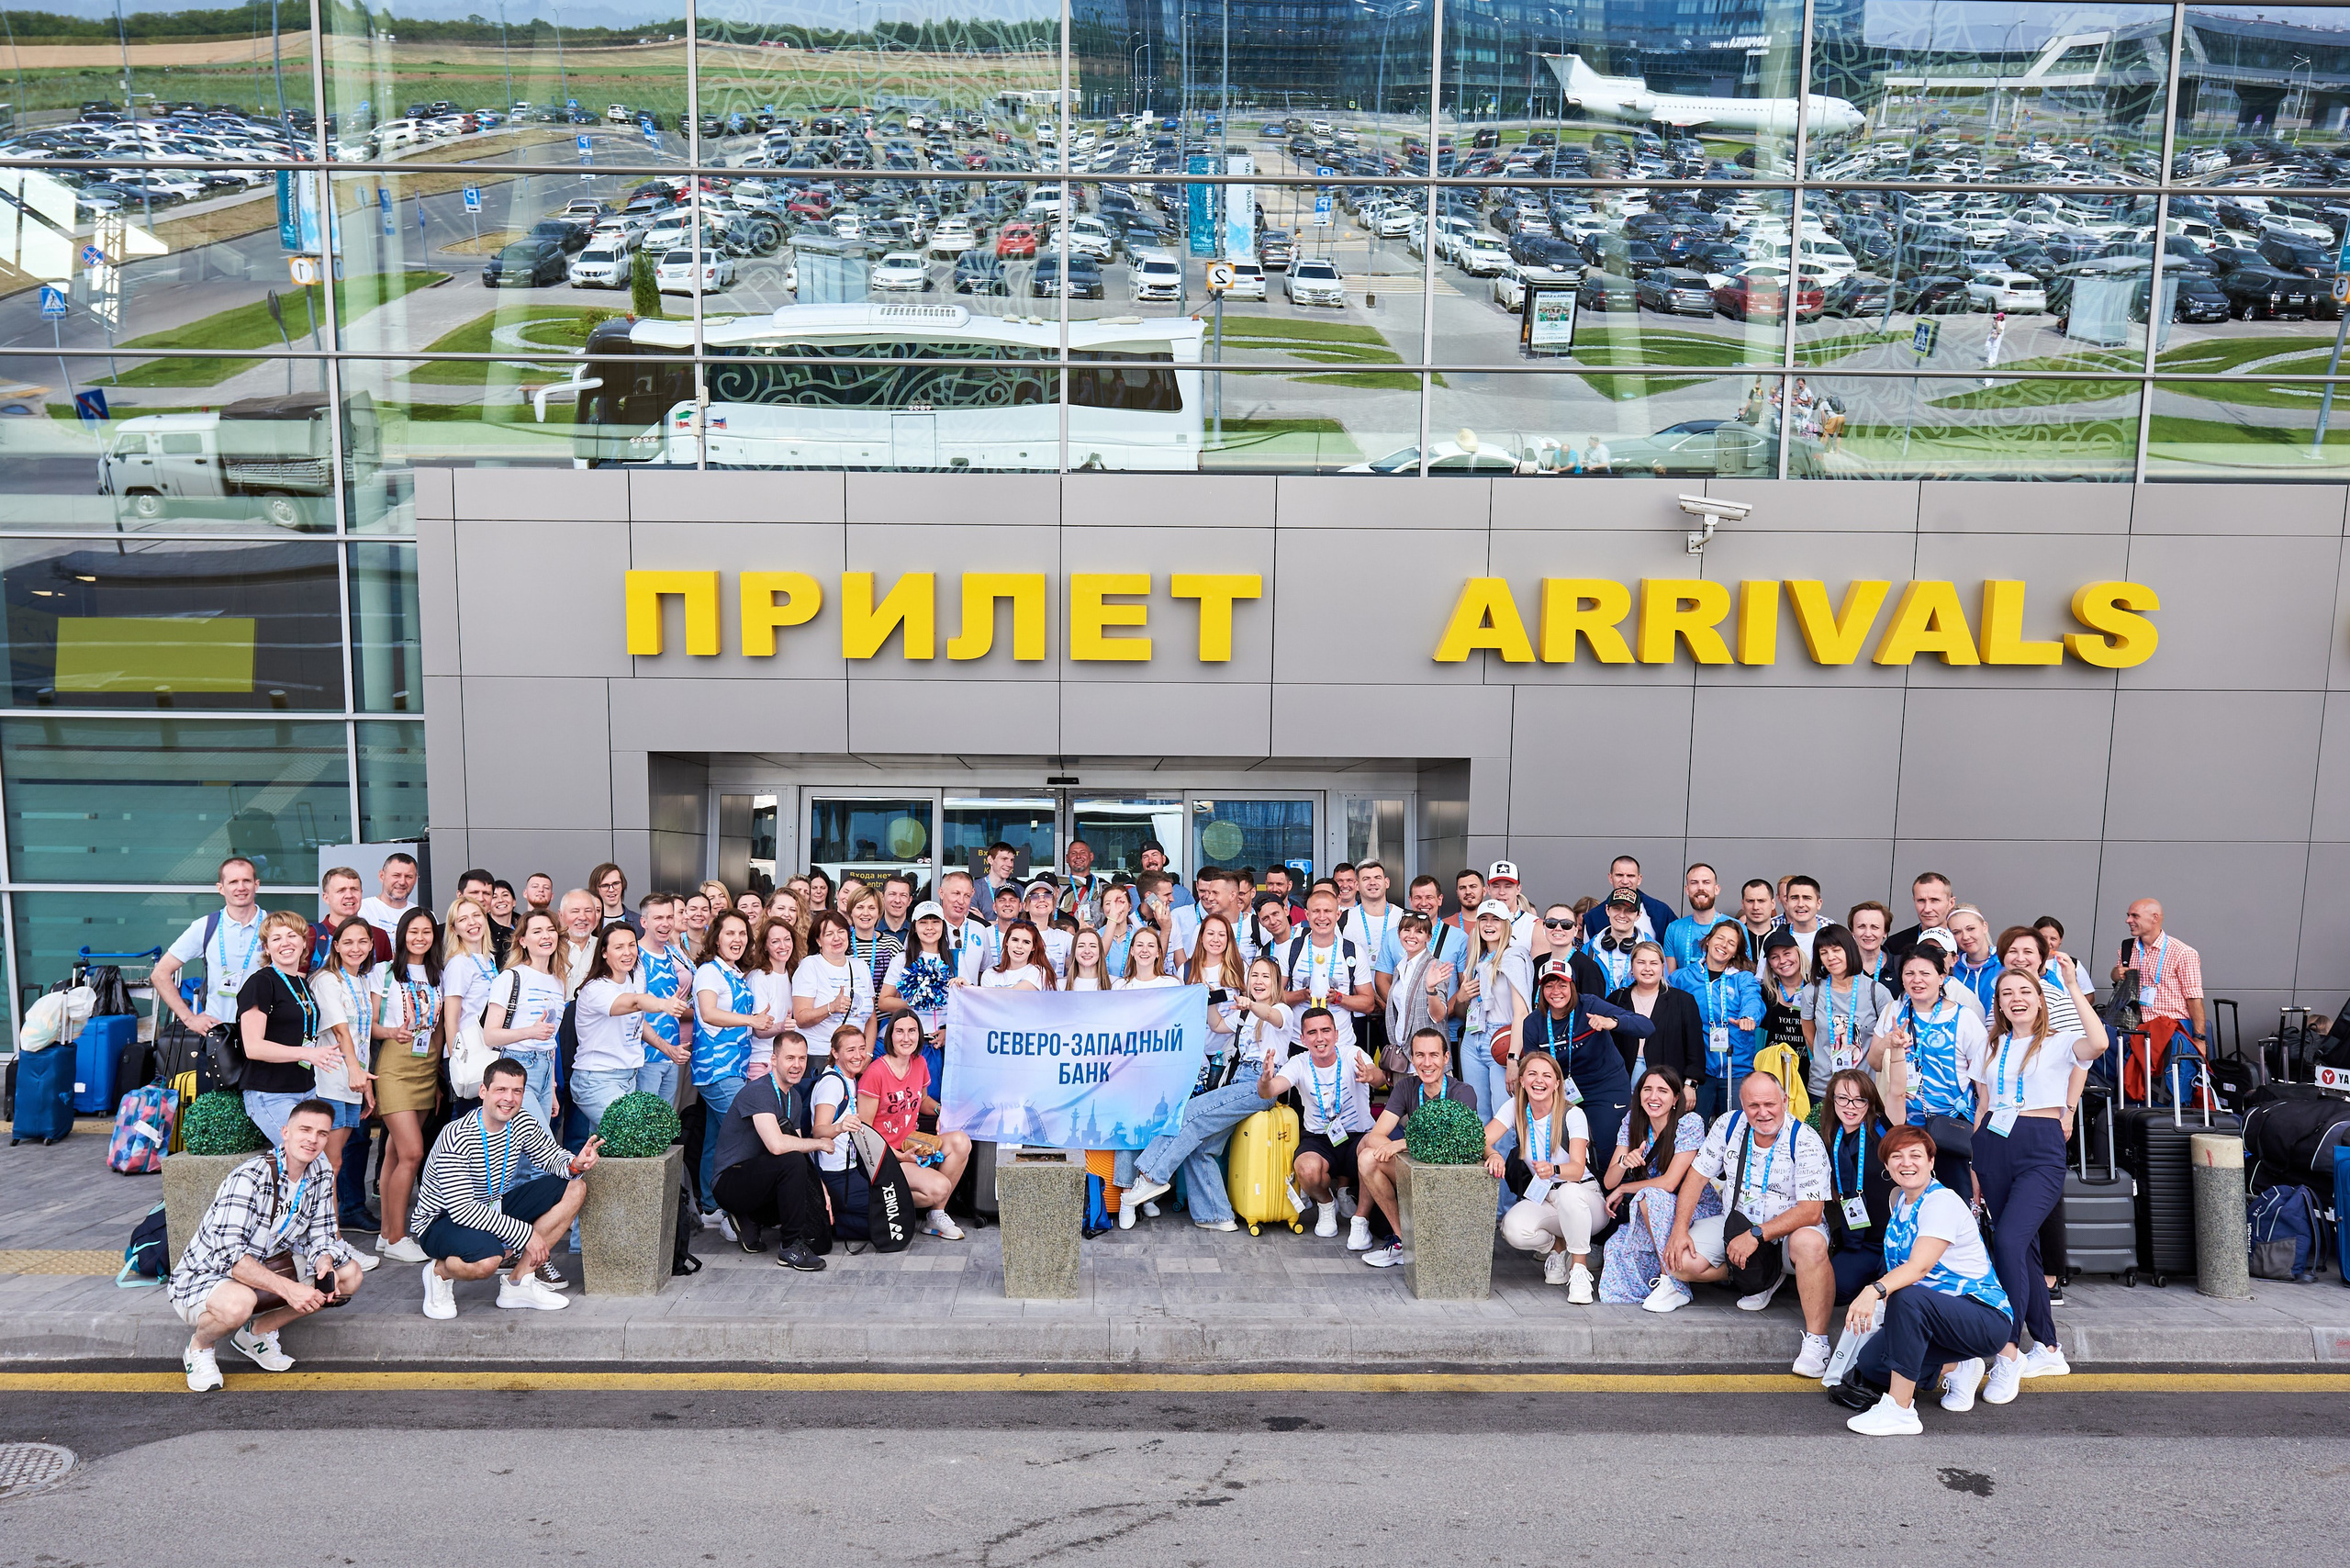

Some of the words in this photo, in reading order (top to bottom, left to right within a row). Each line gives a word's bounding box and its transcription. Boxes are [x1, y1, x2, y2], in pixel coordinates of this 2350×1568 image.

[625, 570, 1263, 662] ПРИЛЕТ
[1432, 577, 2162, 669] ARRIVALS
[849, 871, 875, 880] Входа
[987, 1024, 1184, 1057] СЕВЕРО-ЗАПАДНЫЙ
[1774, 1034, 1804, 1043] FAVORIT
[1058, 1061, 1112, 1085] БАНК
[882, 1182, 901, 1222] YONEX
[253, 1341, 269, 1354] N
